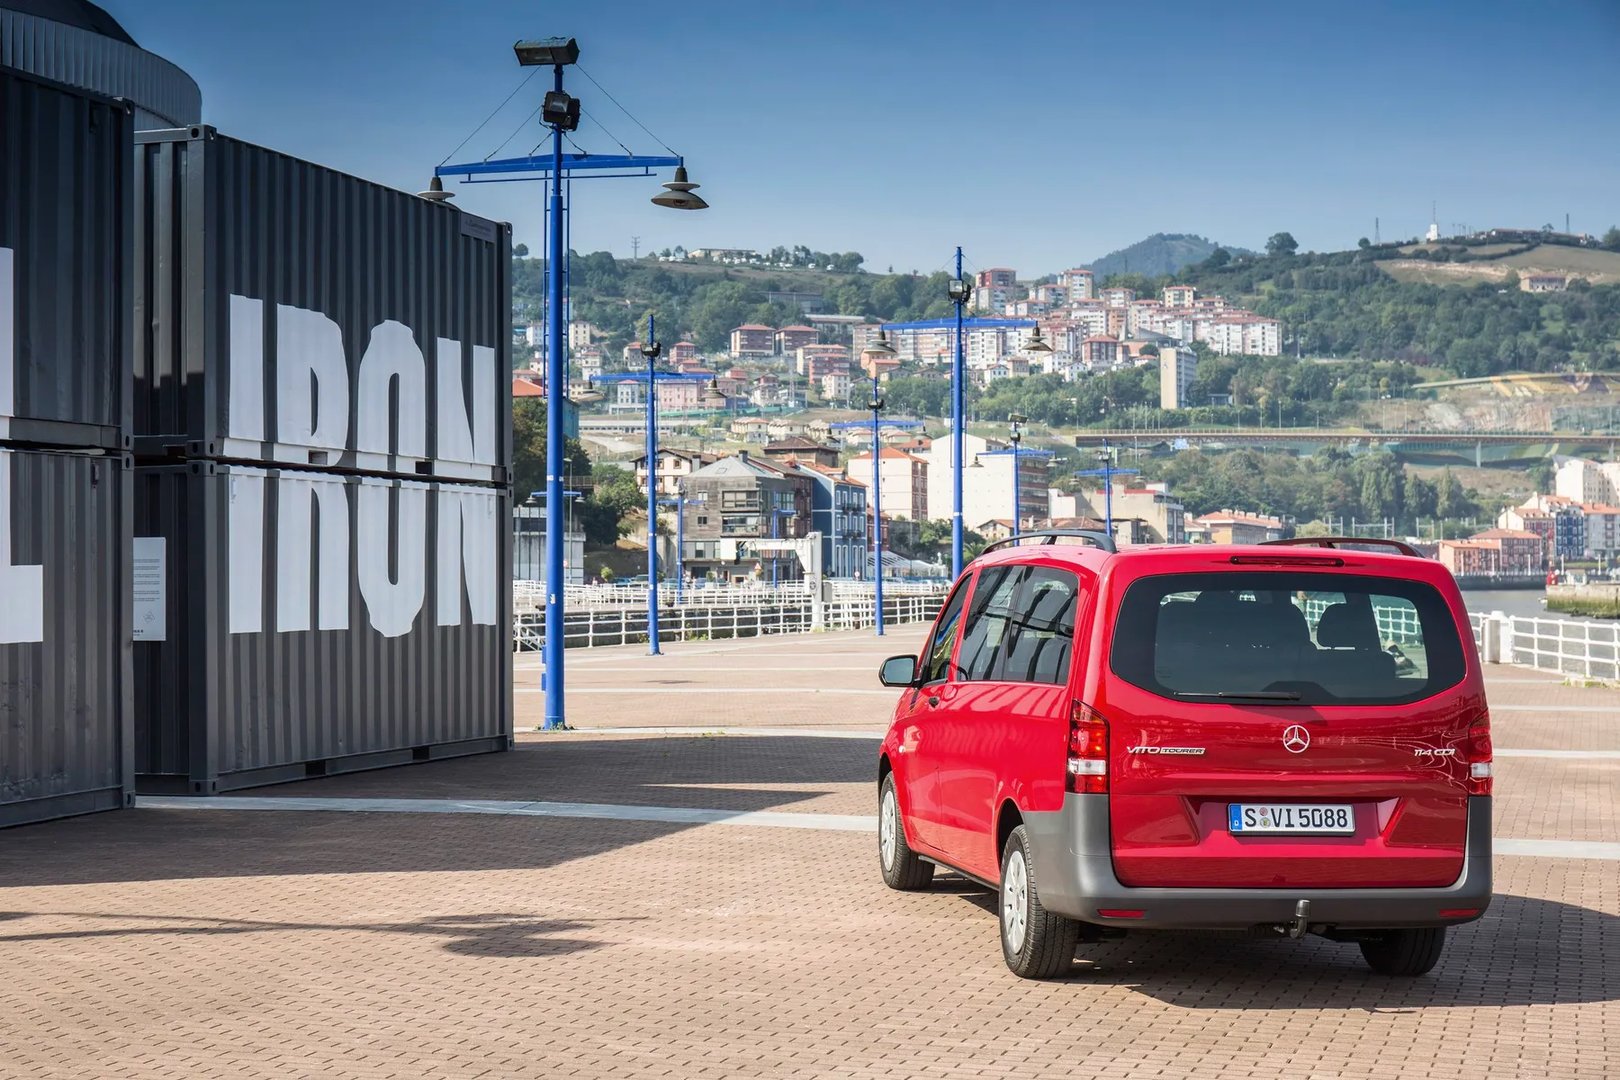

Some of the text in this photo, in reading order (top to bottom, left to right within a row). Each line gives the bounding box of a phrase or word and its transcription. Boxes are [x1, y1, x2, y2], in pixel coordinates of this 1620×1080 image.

[224, 293, 497, 638] IRON
[1126, 746, 1206, 755] VITO TOURER
[1433, 748, 1456, 756] CDI
[1244, 808, 1257, 828] S
